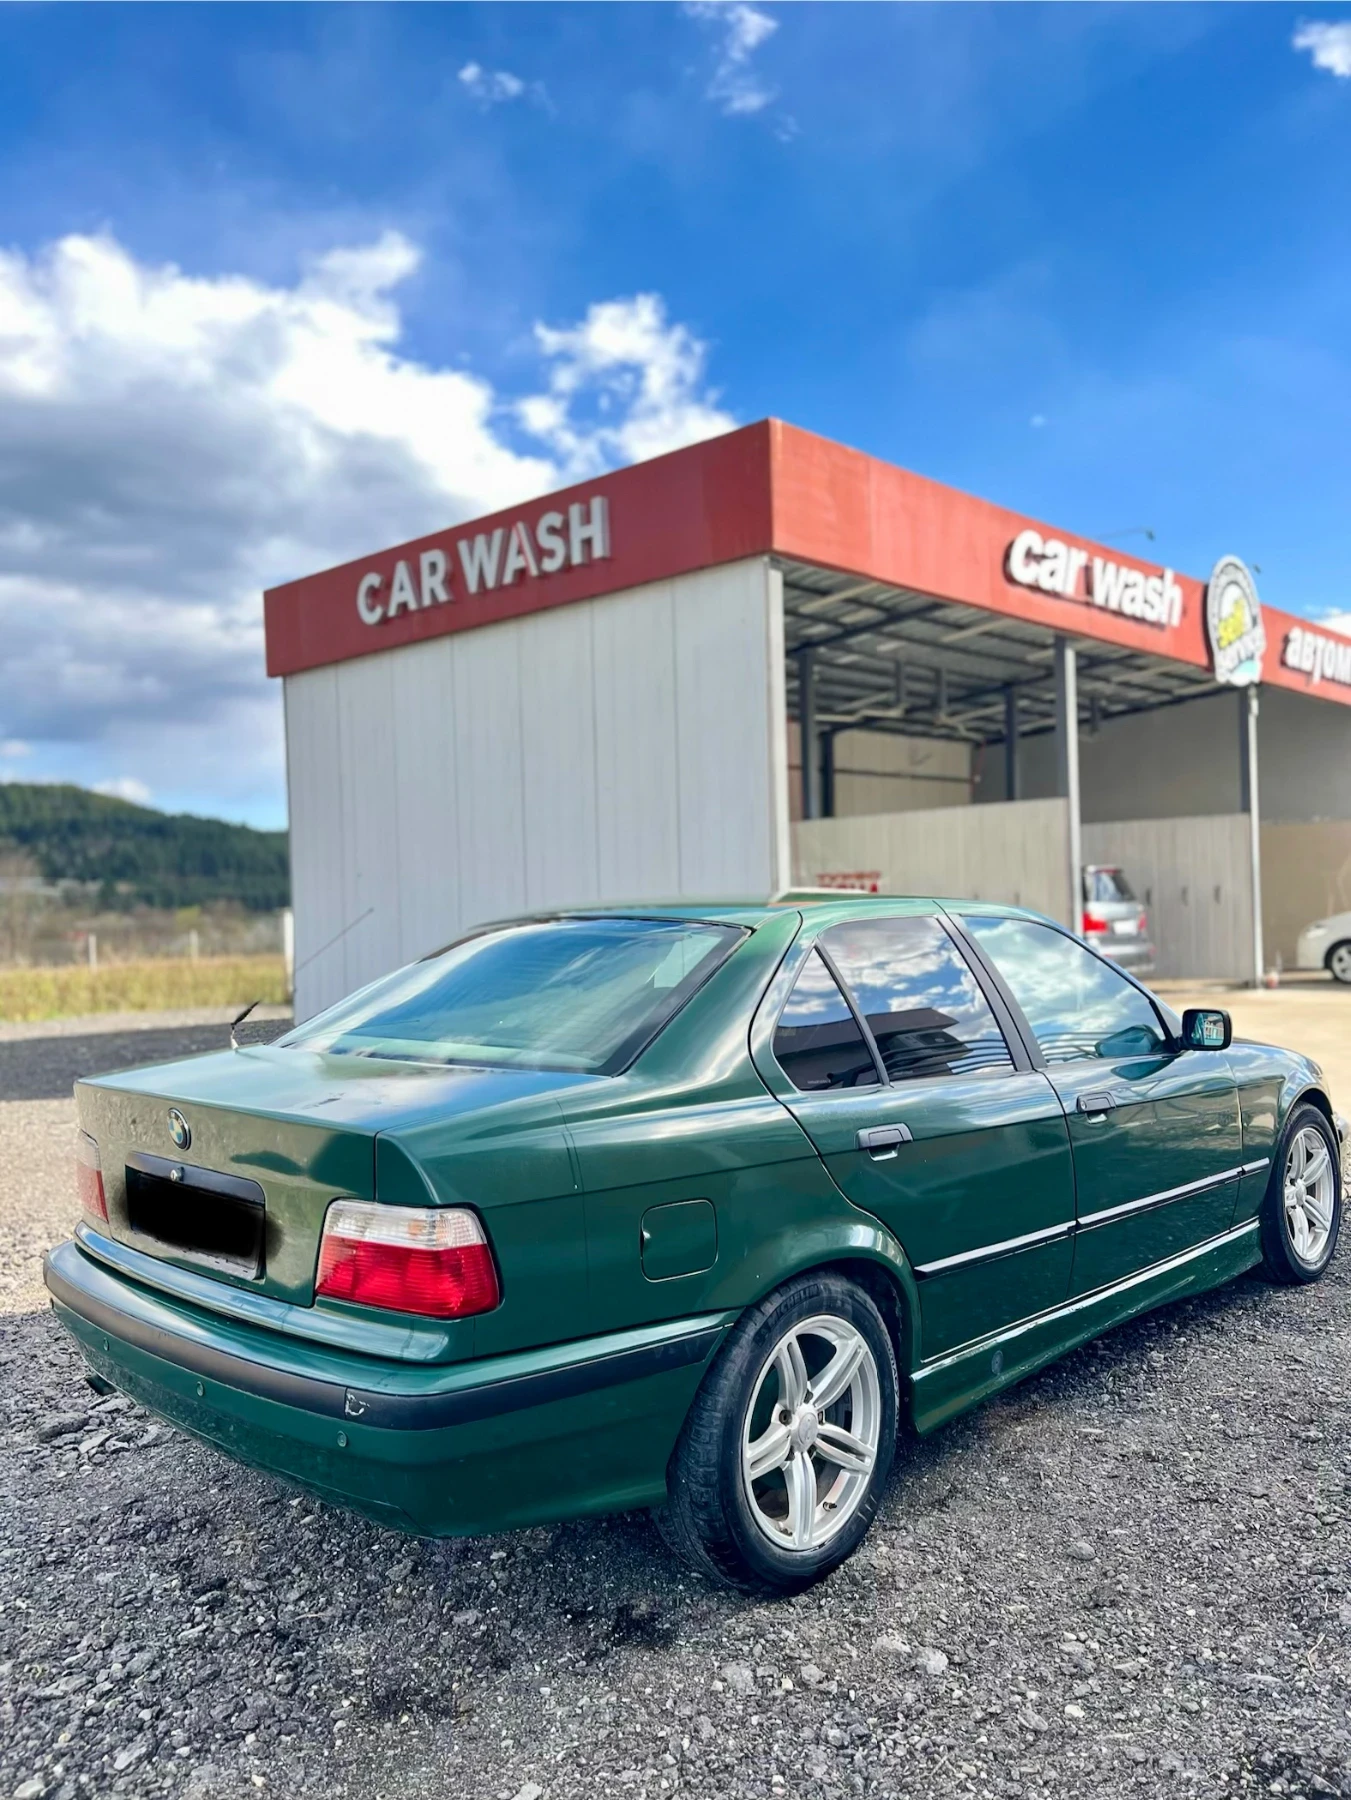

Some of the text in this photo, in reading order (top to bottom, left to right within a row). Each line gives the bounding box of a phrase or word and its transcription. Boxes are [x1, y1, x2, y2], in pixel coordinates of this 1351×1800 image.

[356, 496, 609, 625] CAR WASH
[1009, 529, 1183, 627] car wash
[767, 1284, 819, 1327] MICHELIN
